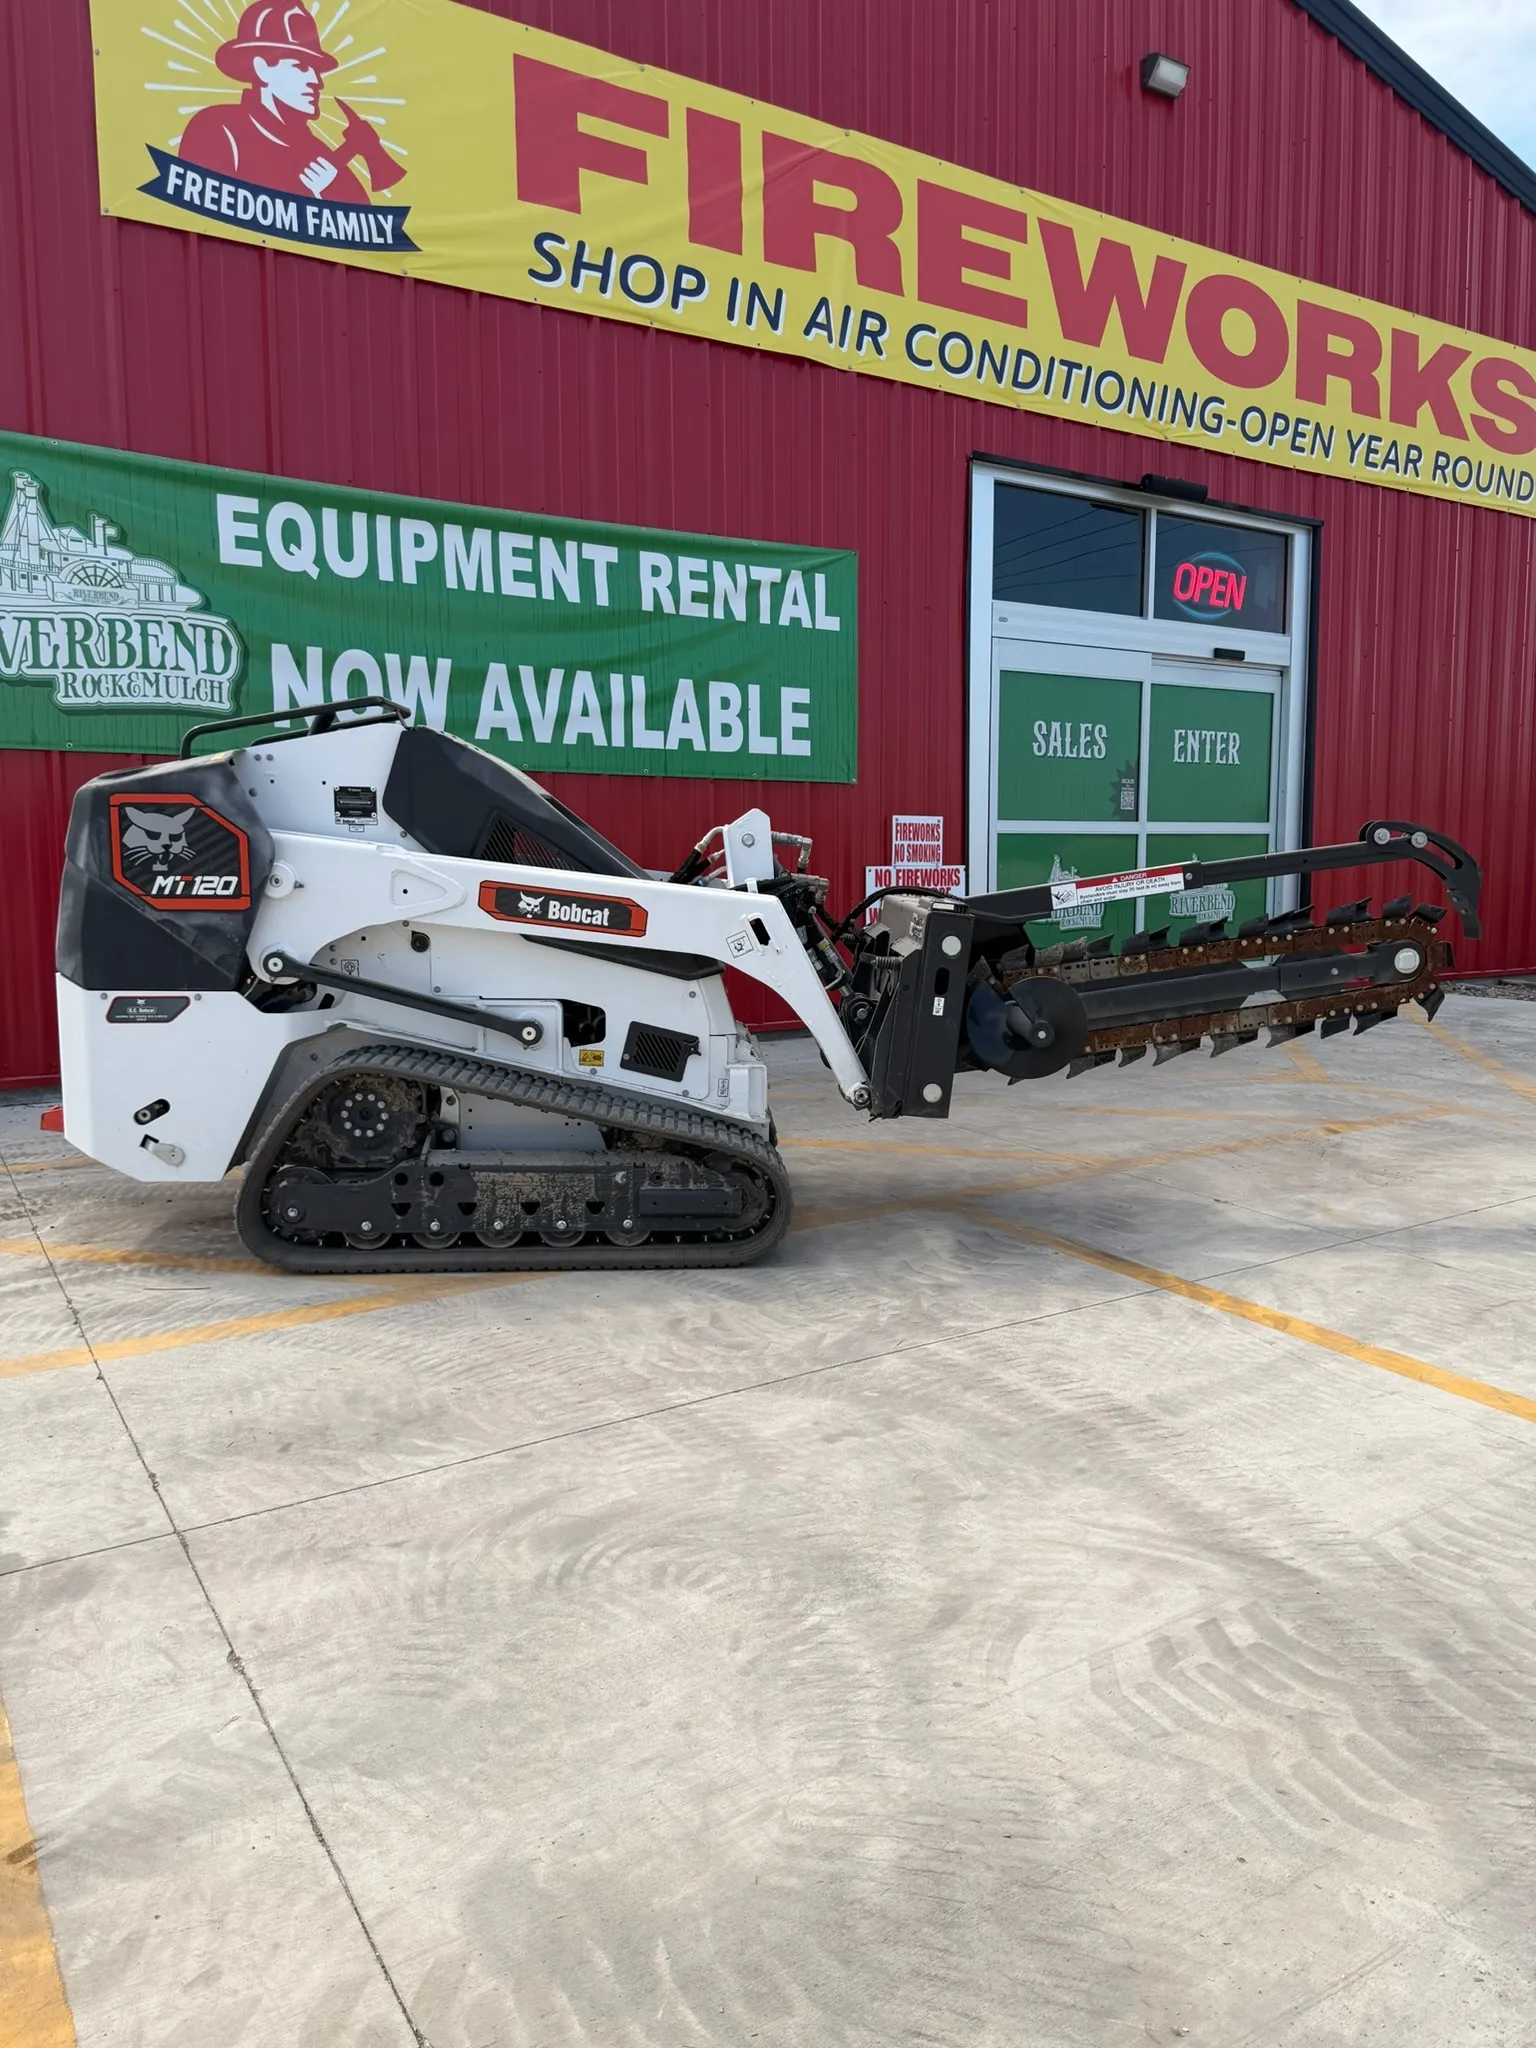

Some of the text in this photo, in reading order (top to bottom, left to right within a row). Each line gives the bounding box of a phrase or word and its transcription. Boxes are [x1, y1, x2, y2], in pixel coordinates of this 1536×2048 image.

[166, 163, 394, 245] FREEDOM FAMILY
[513, 53, 1536, 455] FIREWORKS
[527, 231, 1536, 504] SHOP IN AIR CONDITIONING-OPEN YEAR ROUND
[216, 493, 841, 632] EQUIPMENT RENTAL
[1173, 563, 1247, 610] OPEN
[271, 643, 812, 757] NOW AVAILABLE
[1032, 720, 1108, 760] SALES
[1173, 729, 1241, 765] ENTER
[895, 822, 941, 842] FIREWORKS
[894, 843, 941, 863] NO SMOKING
[874, 868, 960, 888] NO FIREWORKS
[1095, 884, 1113, 892] AVOID
[1114, 881, 1134, 889] INJURY
[1146, 877, 1165, 885] DEATH
[1120, 872, 1147, 882] DANGER
[548, 900, 610, 926] Bobcat
[1171, 893, 1234, 914] RIVERBEND
